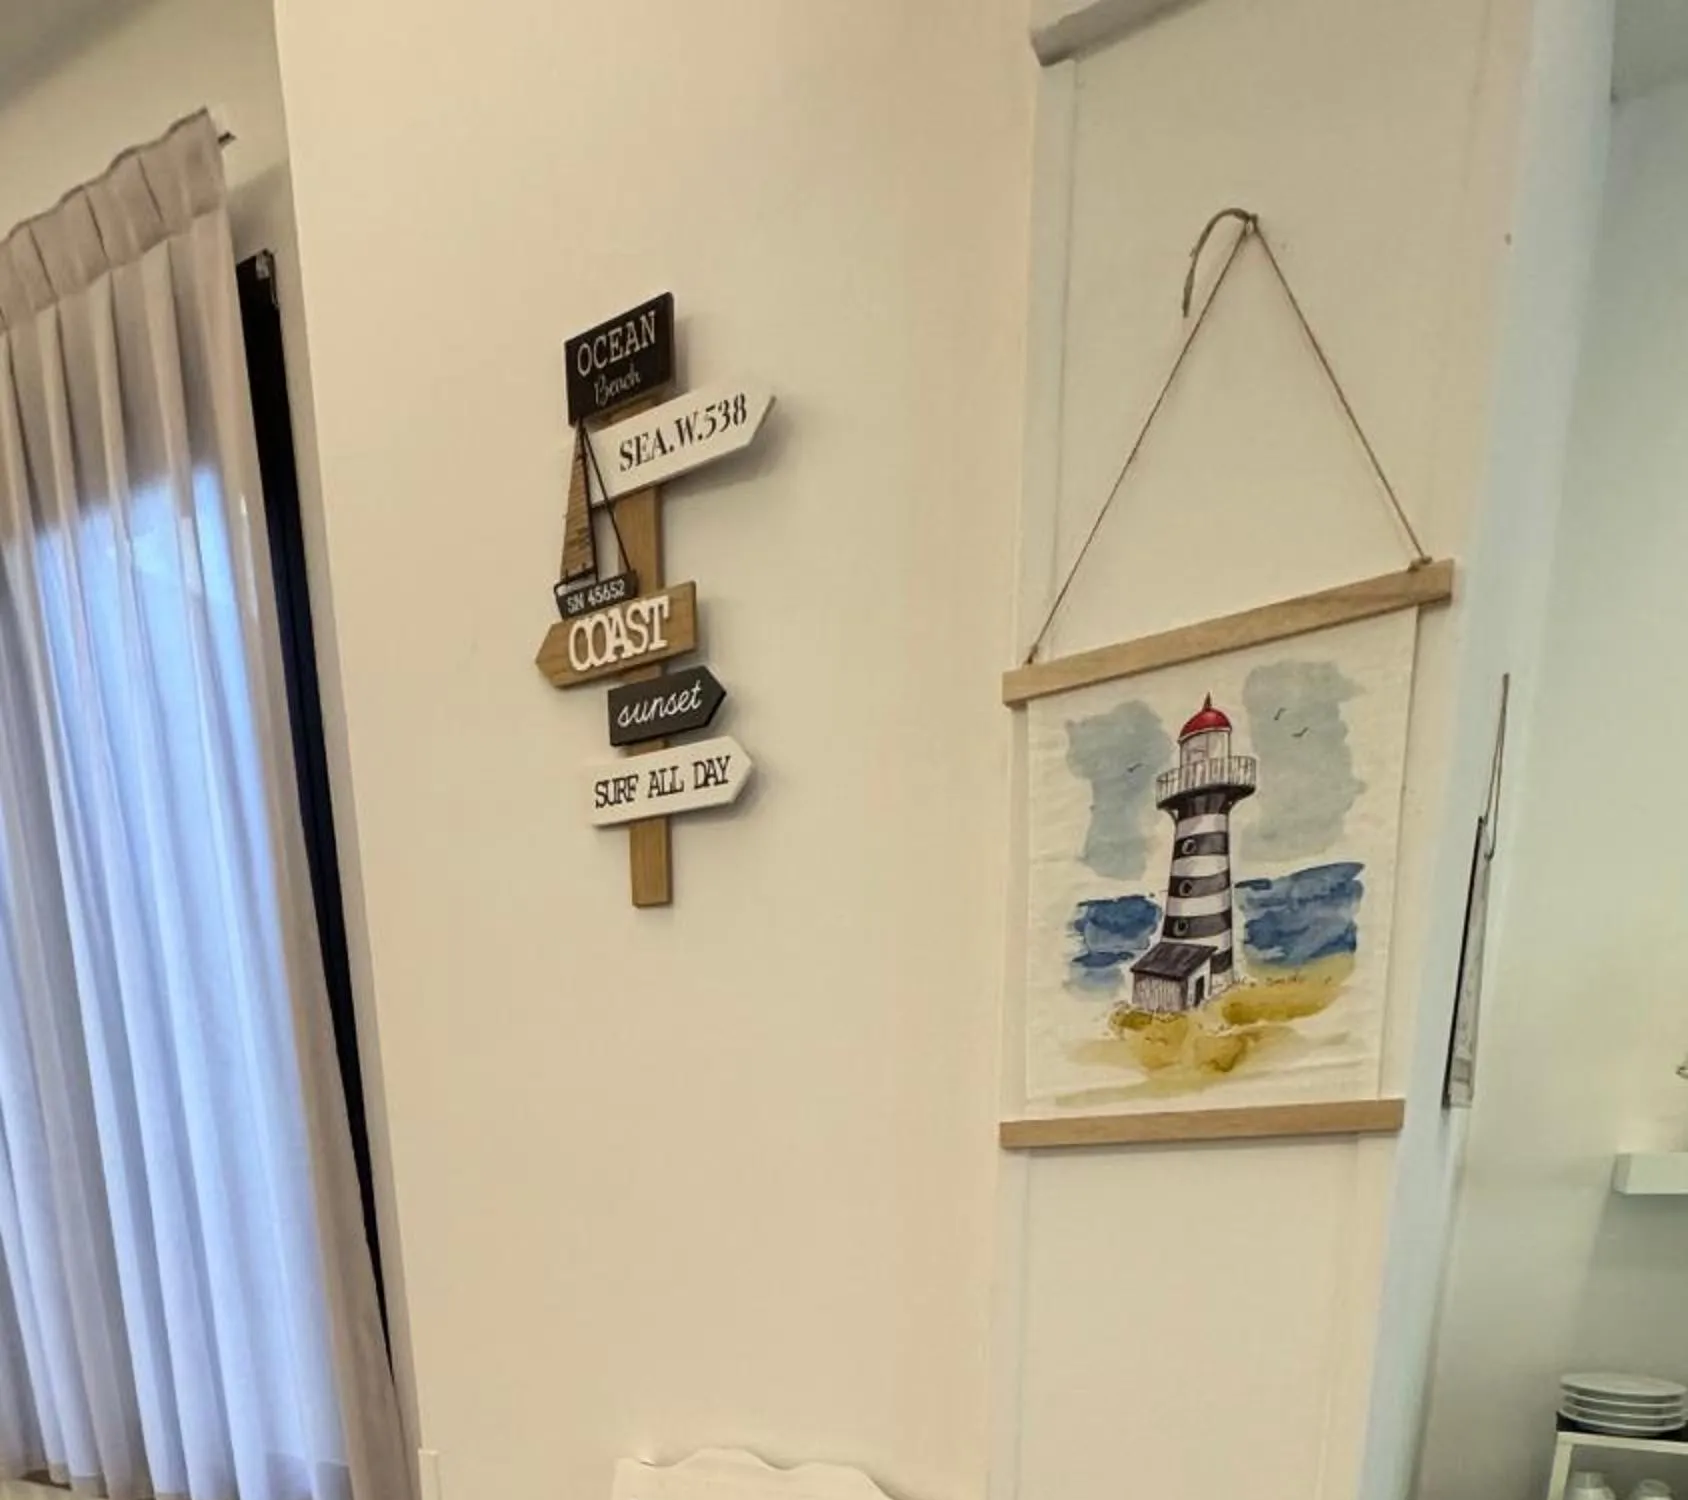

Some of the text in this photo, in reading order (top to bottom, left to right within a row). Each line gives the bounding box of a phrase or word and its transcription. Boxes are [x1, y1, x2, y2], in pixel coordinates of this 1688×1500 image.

[577, 310, 656, 377] OCEAN
[619, 393, 747, 472] SEA.W.538
[569, 595, 669, 671] COAST
[617, 680, 703, 727] sunset
[595, 755, 731, 809] SURF ALL DAY
